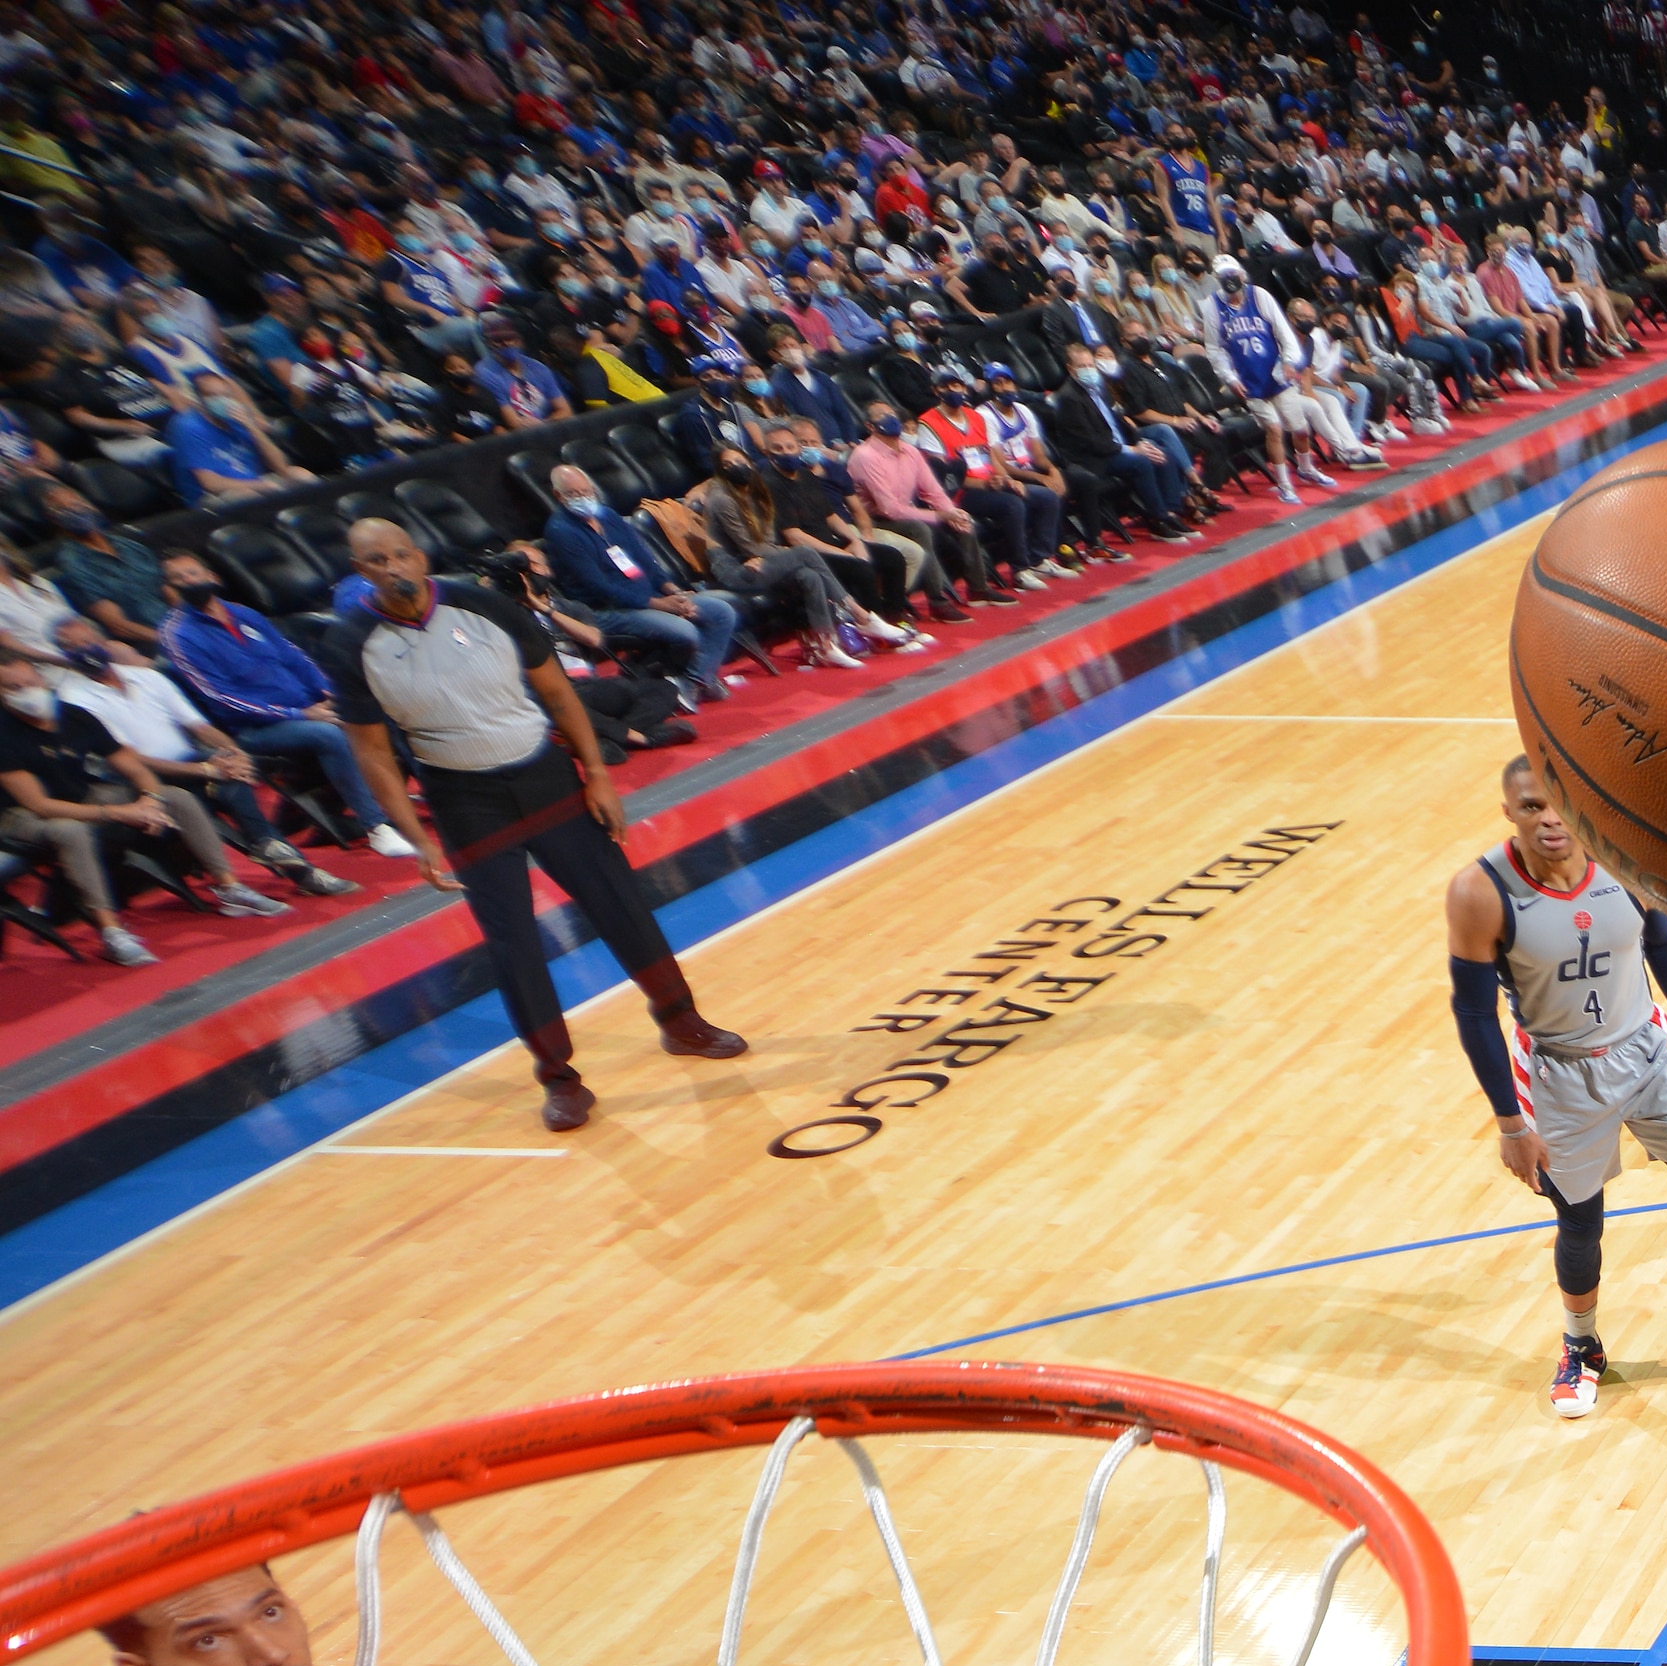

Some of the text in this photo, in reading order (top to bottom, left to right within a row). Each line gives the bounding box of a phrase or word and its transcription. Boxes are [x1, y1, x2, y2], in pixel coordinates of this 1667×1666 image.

[1184, 193, 1204, 211] 76
[1237, 336, 1265, 356] 76
[1589, 884, 1621, 899] GEICO
[849, 896, 1121, 1033] CENTER
[766, 820, 1346, 1159] WELLS FARGO
[1583, 989, 1605, 1025] 4
